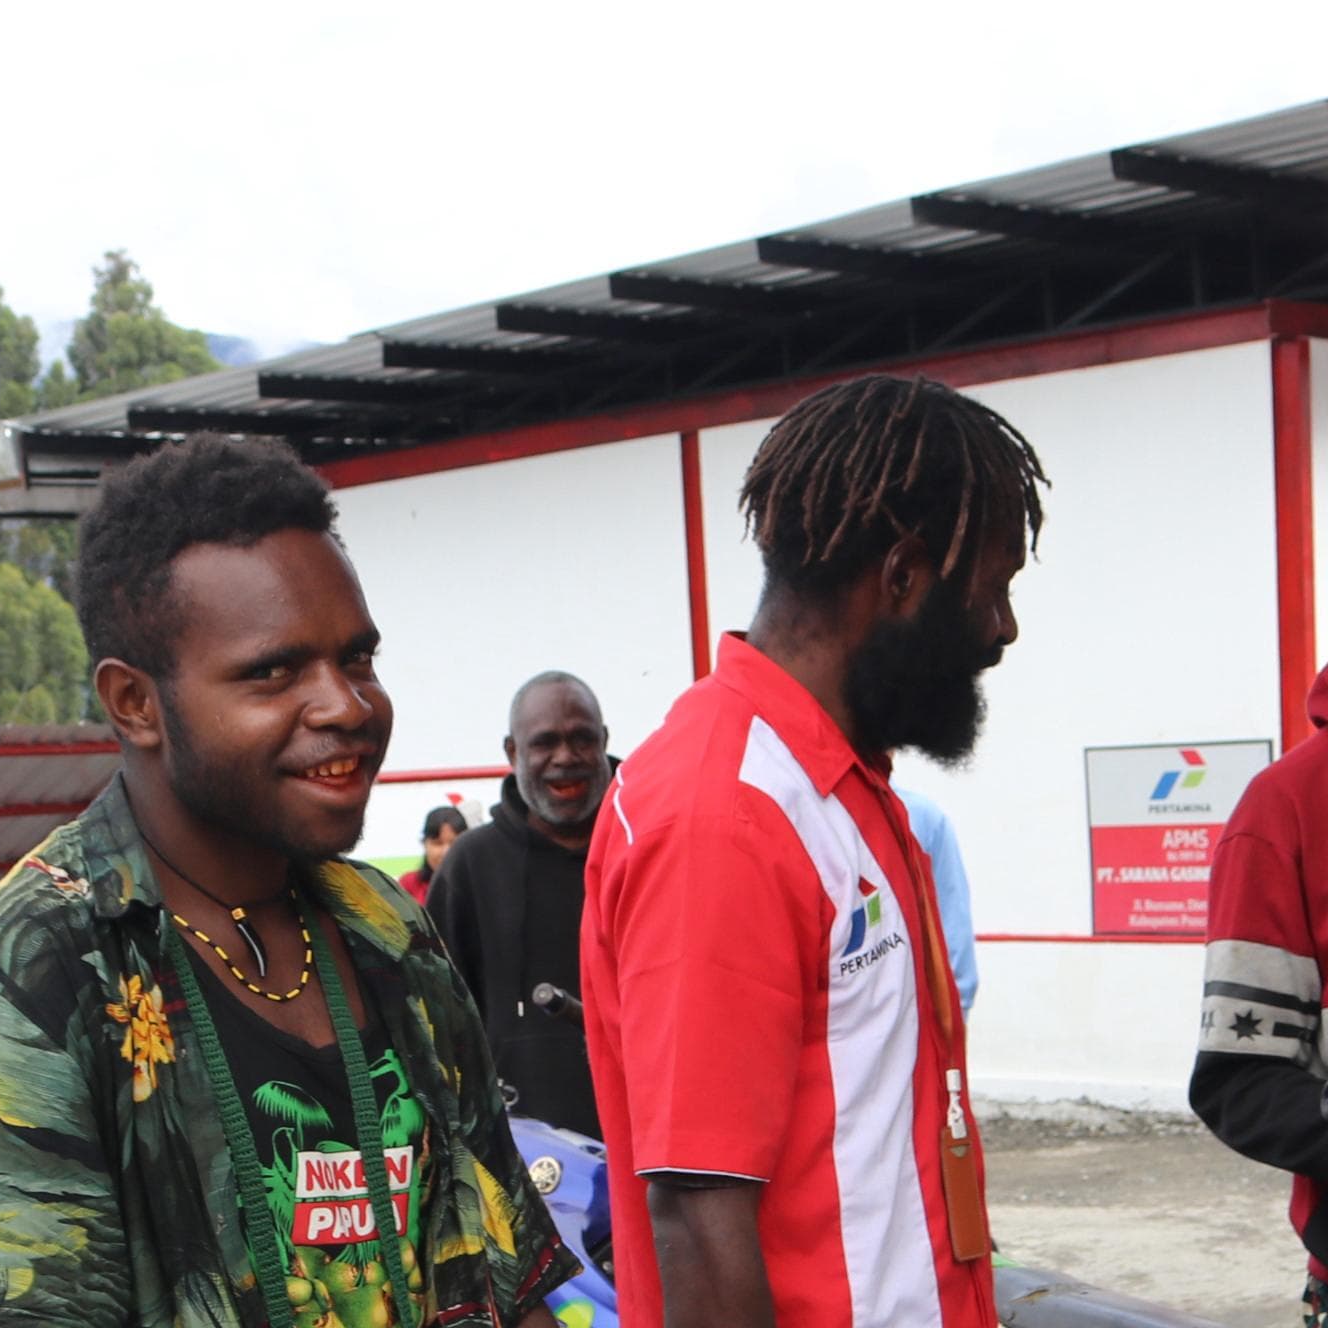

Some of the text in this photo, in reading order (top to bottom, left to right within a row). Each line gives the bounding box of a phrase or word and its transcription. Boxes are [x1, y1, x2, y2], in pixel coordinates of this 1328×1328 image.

[1162, 829, 1210, 850] APMS
[840, 931, 904, 977] PERTAMINA
[307, 1199, 402, 1240] PAPU
